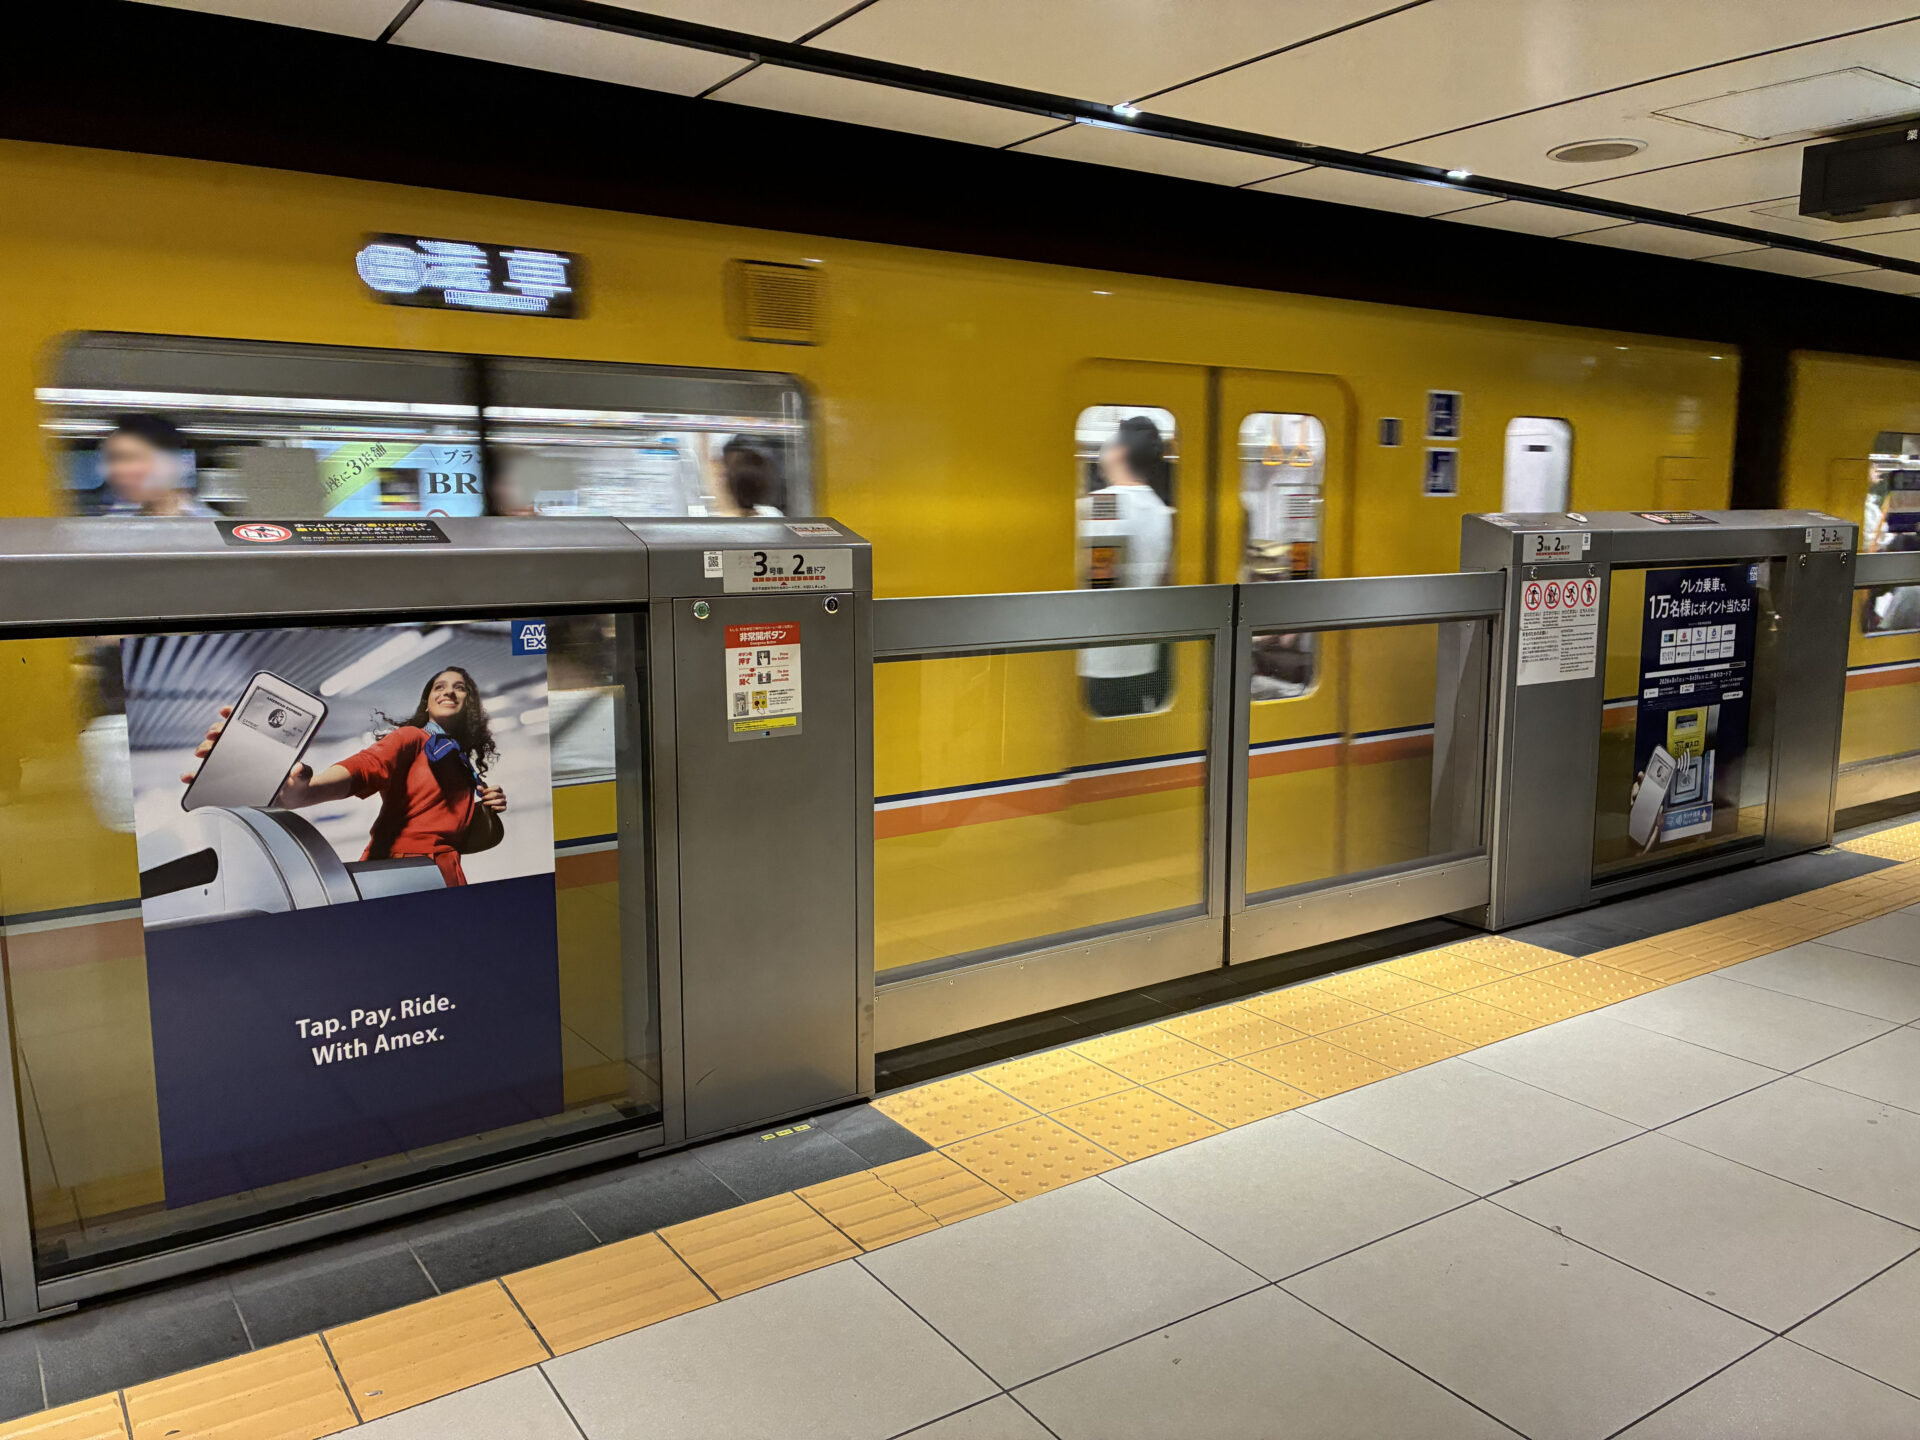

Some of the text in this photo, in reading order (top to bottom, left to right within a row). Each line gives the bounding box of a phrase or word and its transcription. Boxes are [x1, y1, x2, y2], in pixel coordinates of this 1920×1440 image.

[324, 442, 387, 495] 座に3店舗
[425, 472, 483, 494] BR
[753, 552, 826, 576] 3号車 2番ドア
[1680, 577, 1727, 594] クレカ乗車で、
[296, 994, 456, 1039] Tap. Pay. Ride.
[312, 1027, 445, 1066] With Amex.
